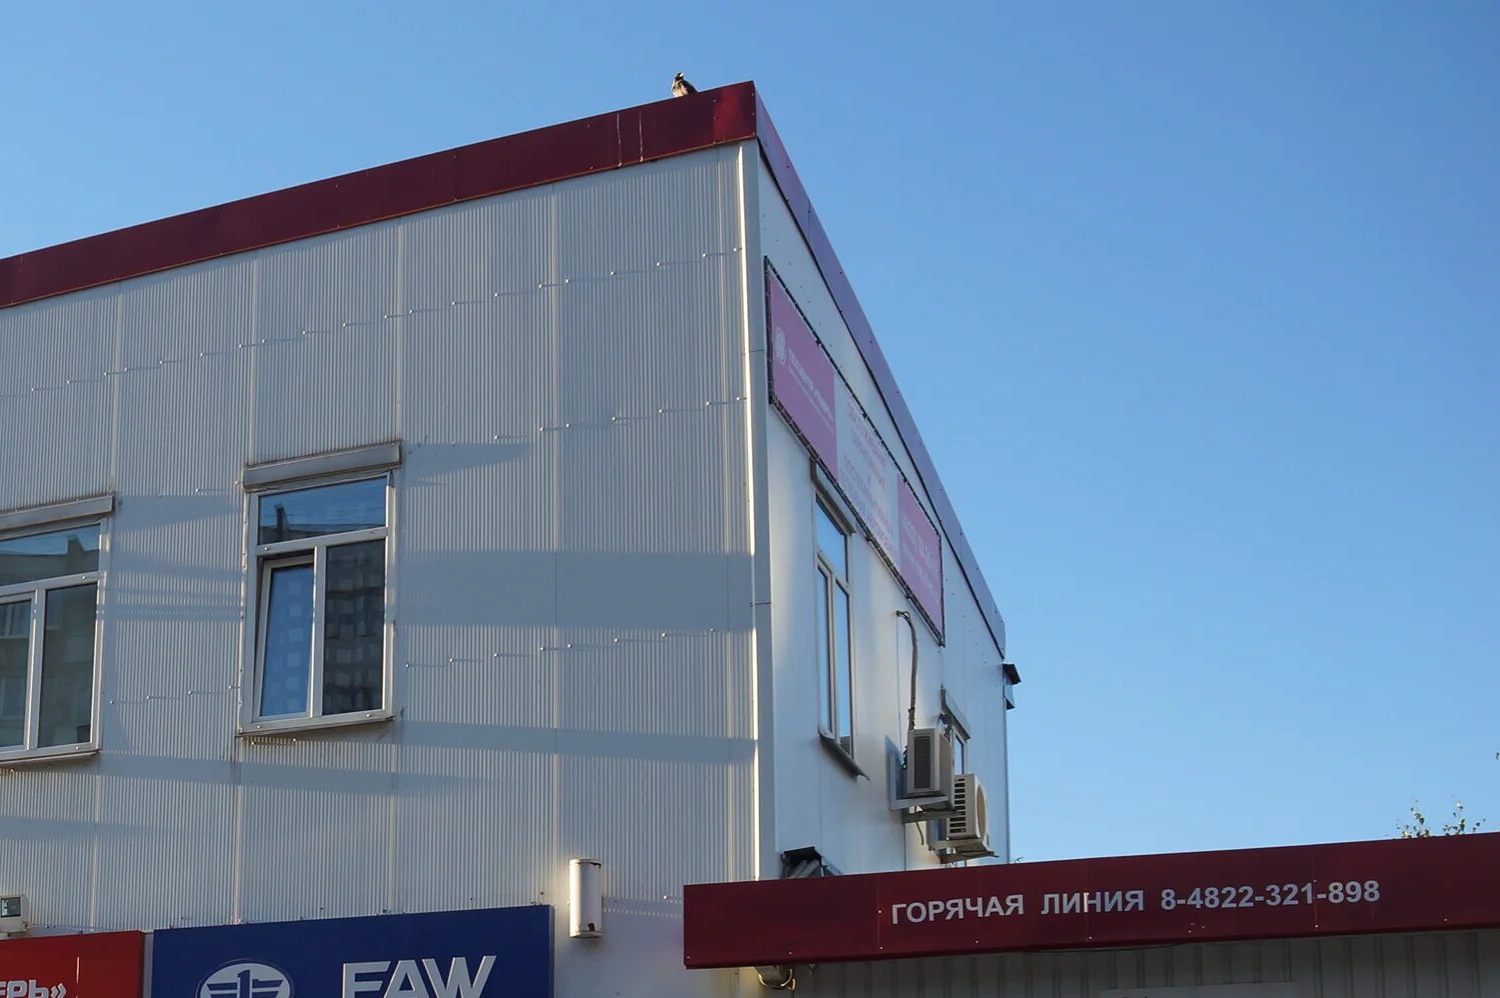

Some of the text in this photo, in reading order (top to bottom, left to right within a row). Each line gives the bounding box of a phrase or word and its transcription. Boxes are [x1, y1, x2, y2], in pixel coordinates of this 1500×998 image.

[891, 880, 1380, 925] ГОРЯЧАЯ ЛИНИЯ 8-4822-321-898
